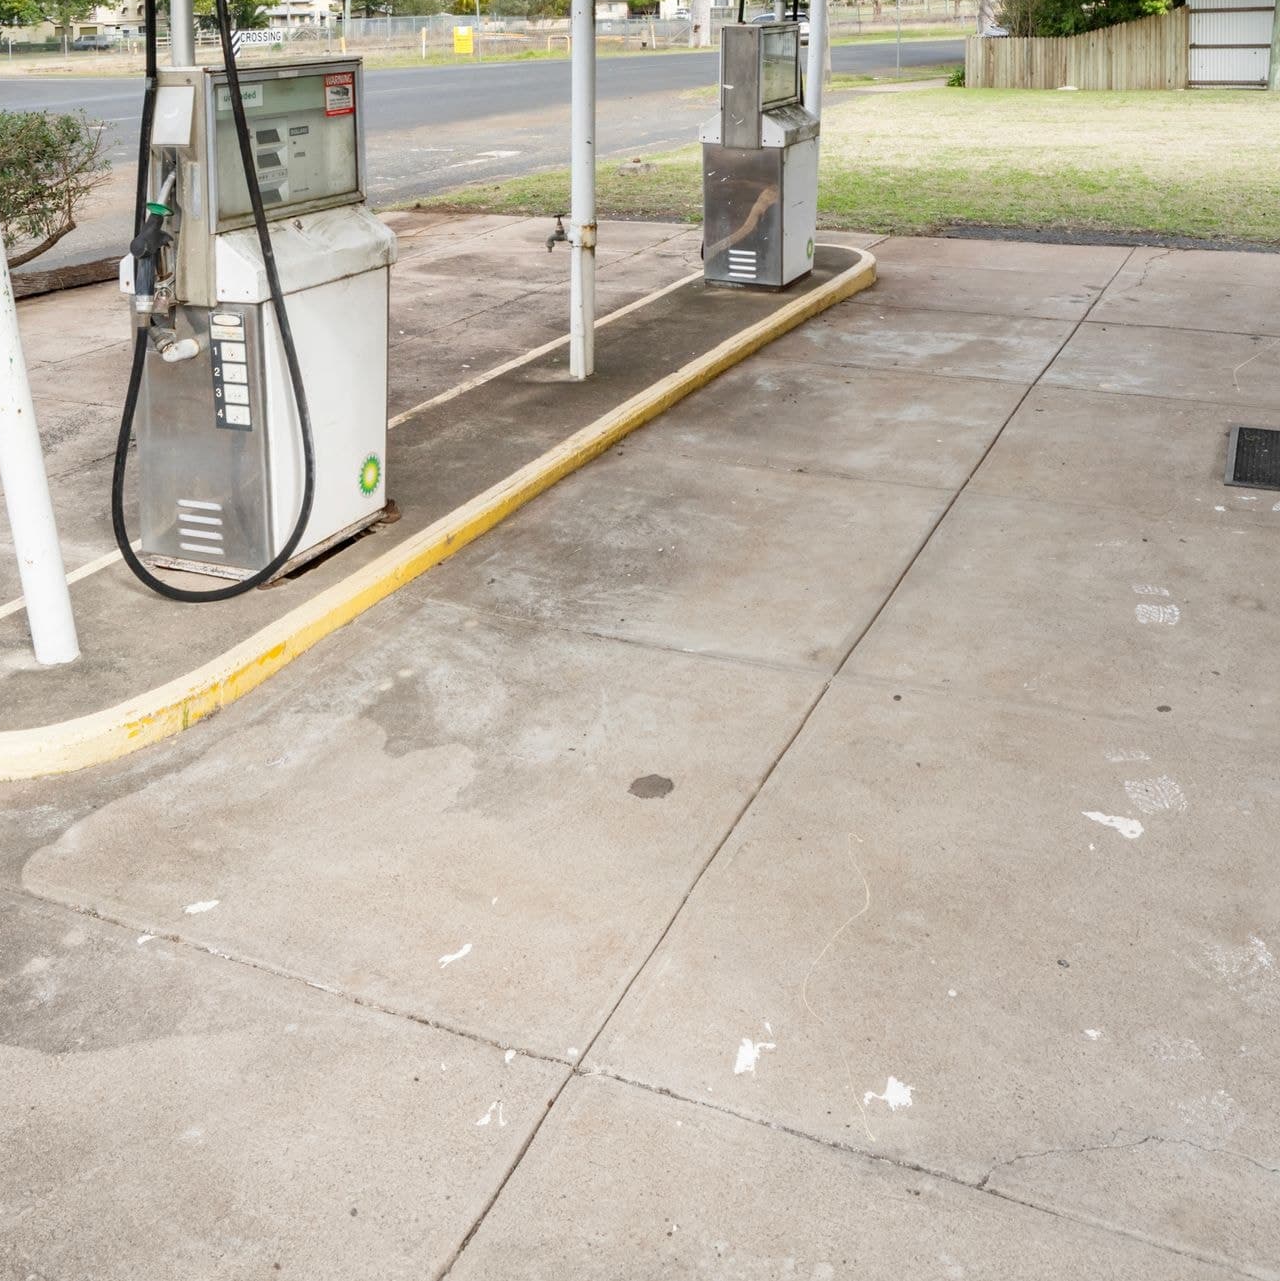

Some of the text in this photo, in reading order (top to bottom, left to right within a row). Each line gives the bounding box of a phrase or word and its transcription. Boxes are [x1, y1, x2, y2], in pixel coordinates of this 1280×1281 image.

[240, 31, 281, 42] CROSSING
[213, 346, 218, 355] 1
[214, 367, 220, 376] 2
[216, 388, 222, 397] 3
[217, 408, 224, 417] 4
